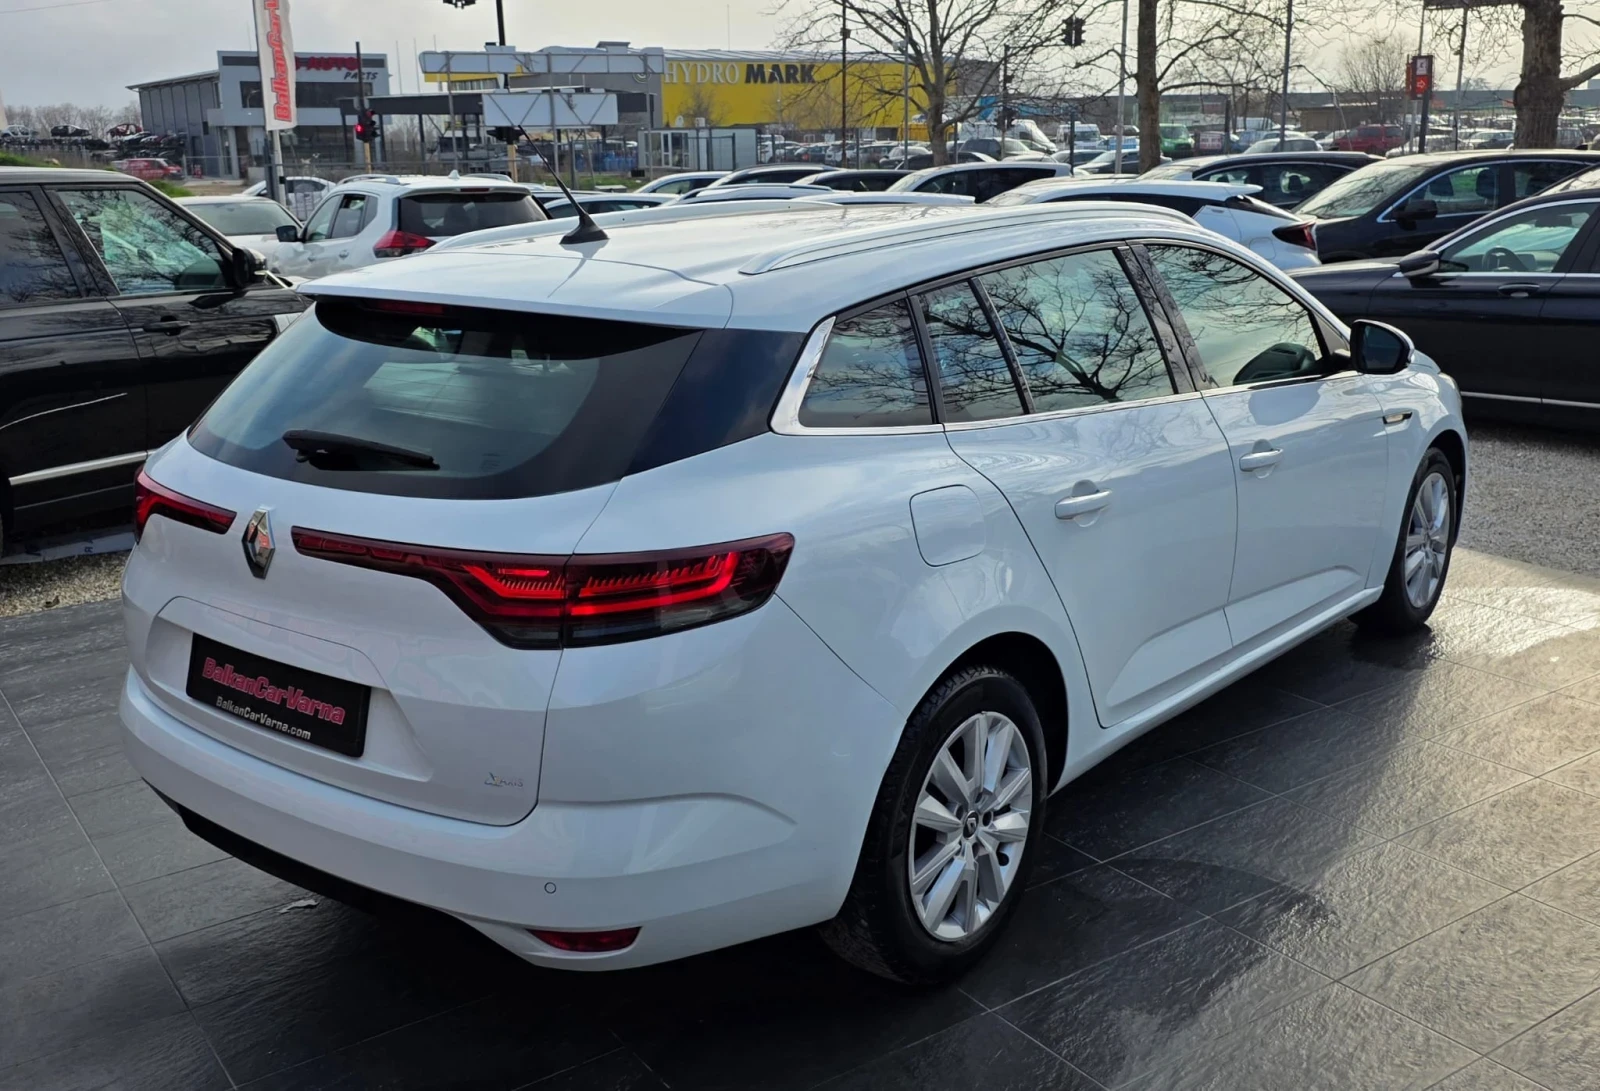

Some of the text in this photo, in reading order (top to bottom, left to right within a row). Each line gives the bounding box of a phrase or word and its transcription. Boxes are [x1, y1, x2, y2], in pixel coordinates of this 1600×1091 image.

[664, 61, 816, 84] HYDRO MARK
[202, 657, 345, 725] BalkanCarVarna
[216, 696, 311, 740] BalkanCarVarna.com
